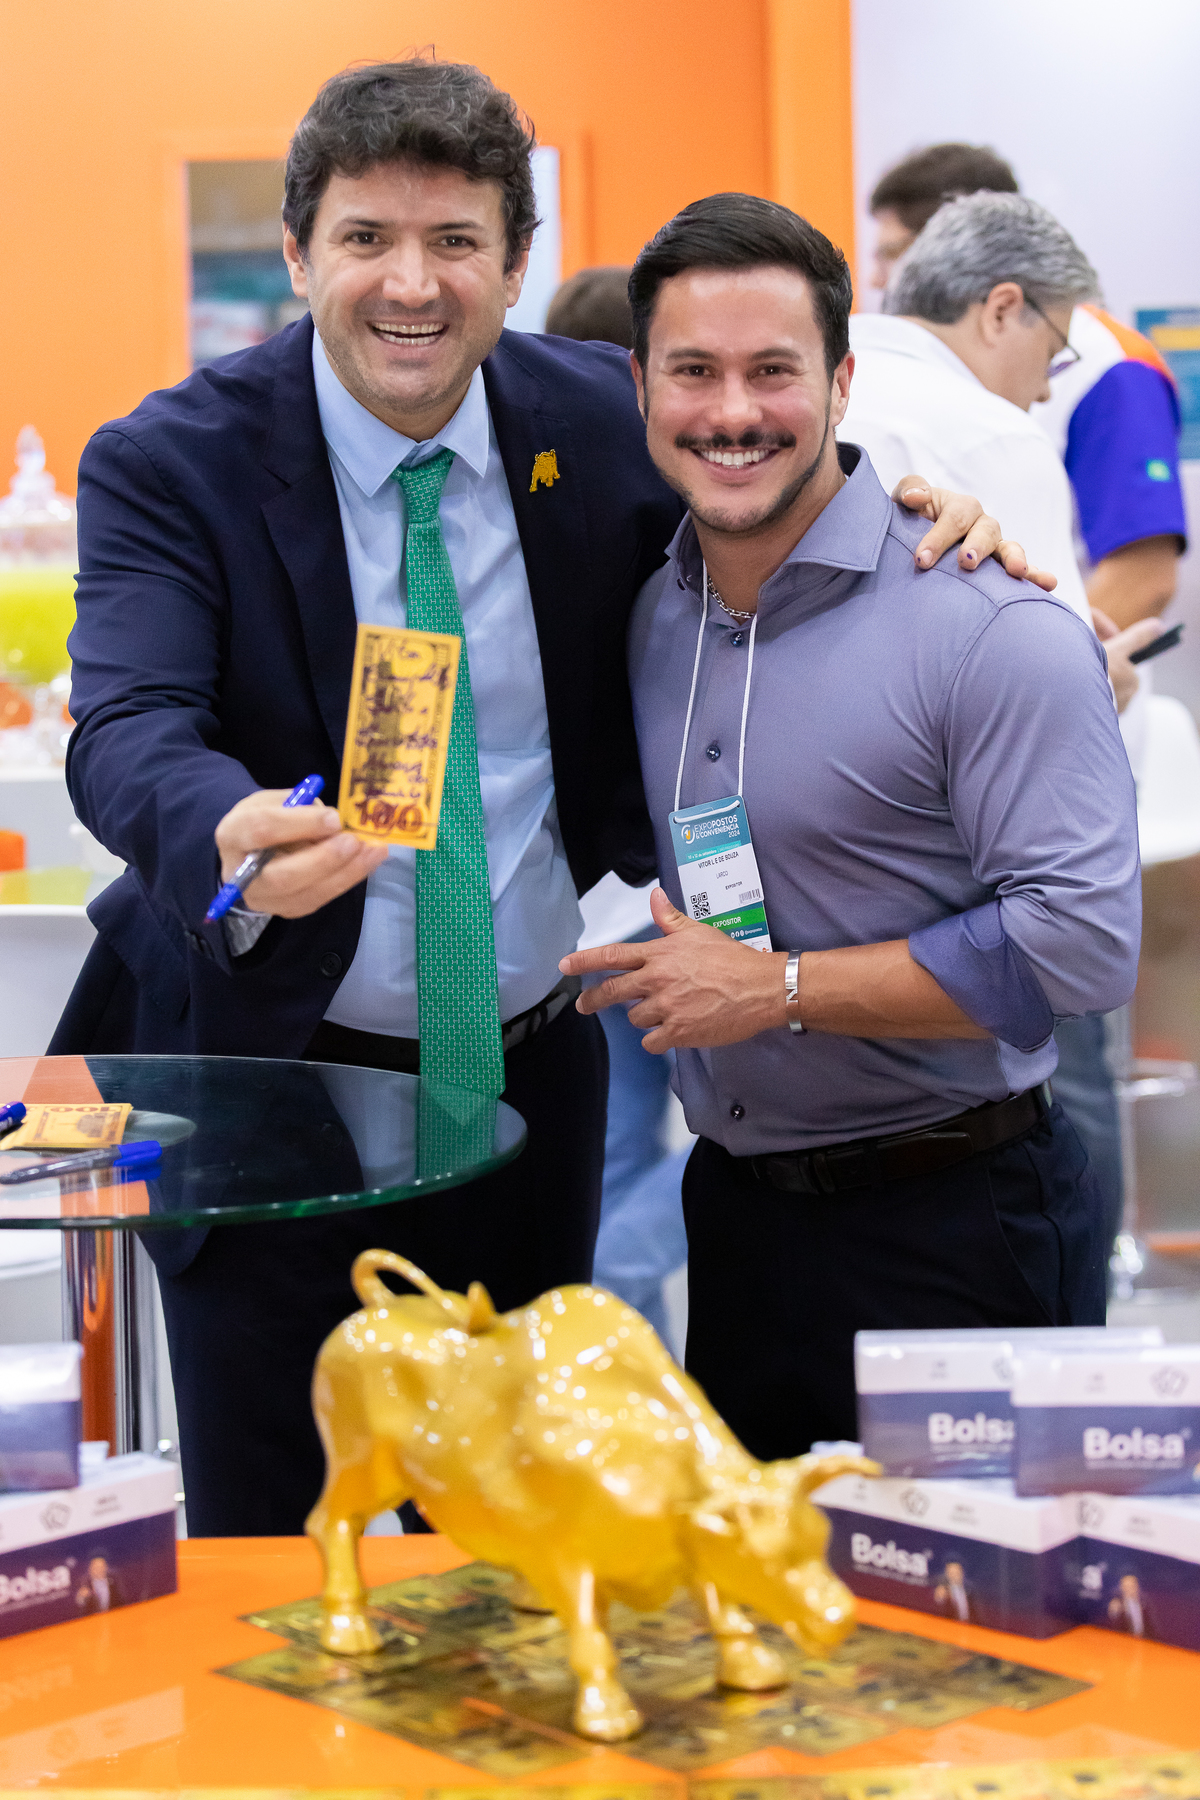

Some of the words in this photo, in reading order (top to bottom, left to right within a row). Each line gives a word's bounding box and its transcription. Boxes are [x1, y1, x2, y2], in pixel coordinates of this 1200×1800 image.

[694, 815, 738, 832] EXPOPOSTOS
[728, 829, 740, 838] 2024
[698, 860, 711, 869] VITOR
[719, 855, 725, 863] DE
[725, 851, 739, 861] SOUZA
[713, 917, 741, 928] EXPOSITOR
[1083, 1428, 1185, 1460] Bolsa
[851, 1533, 928, 1577] Bolsa
